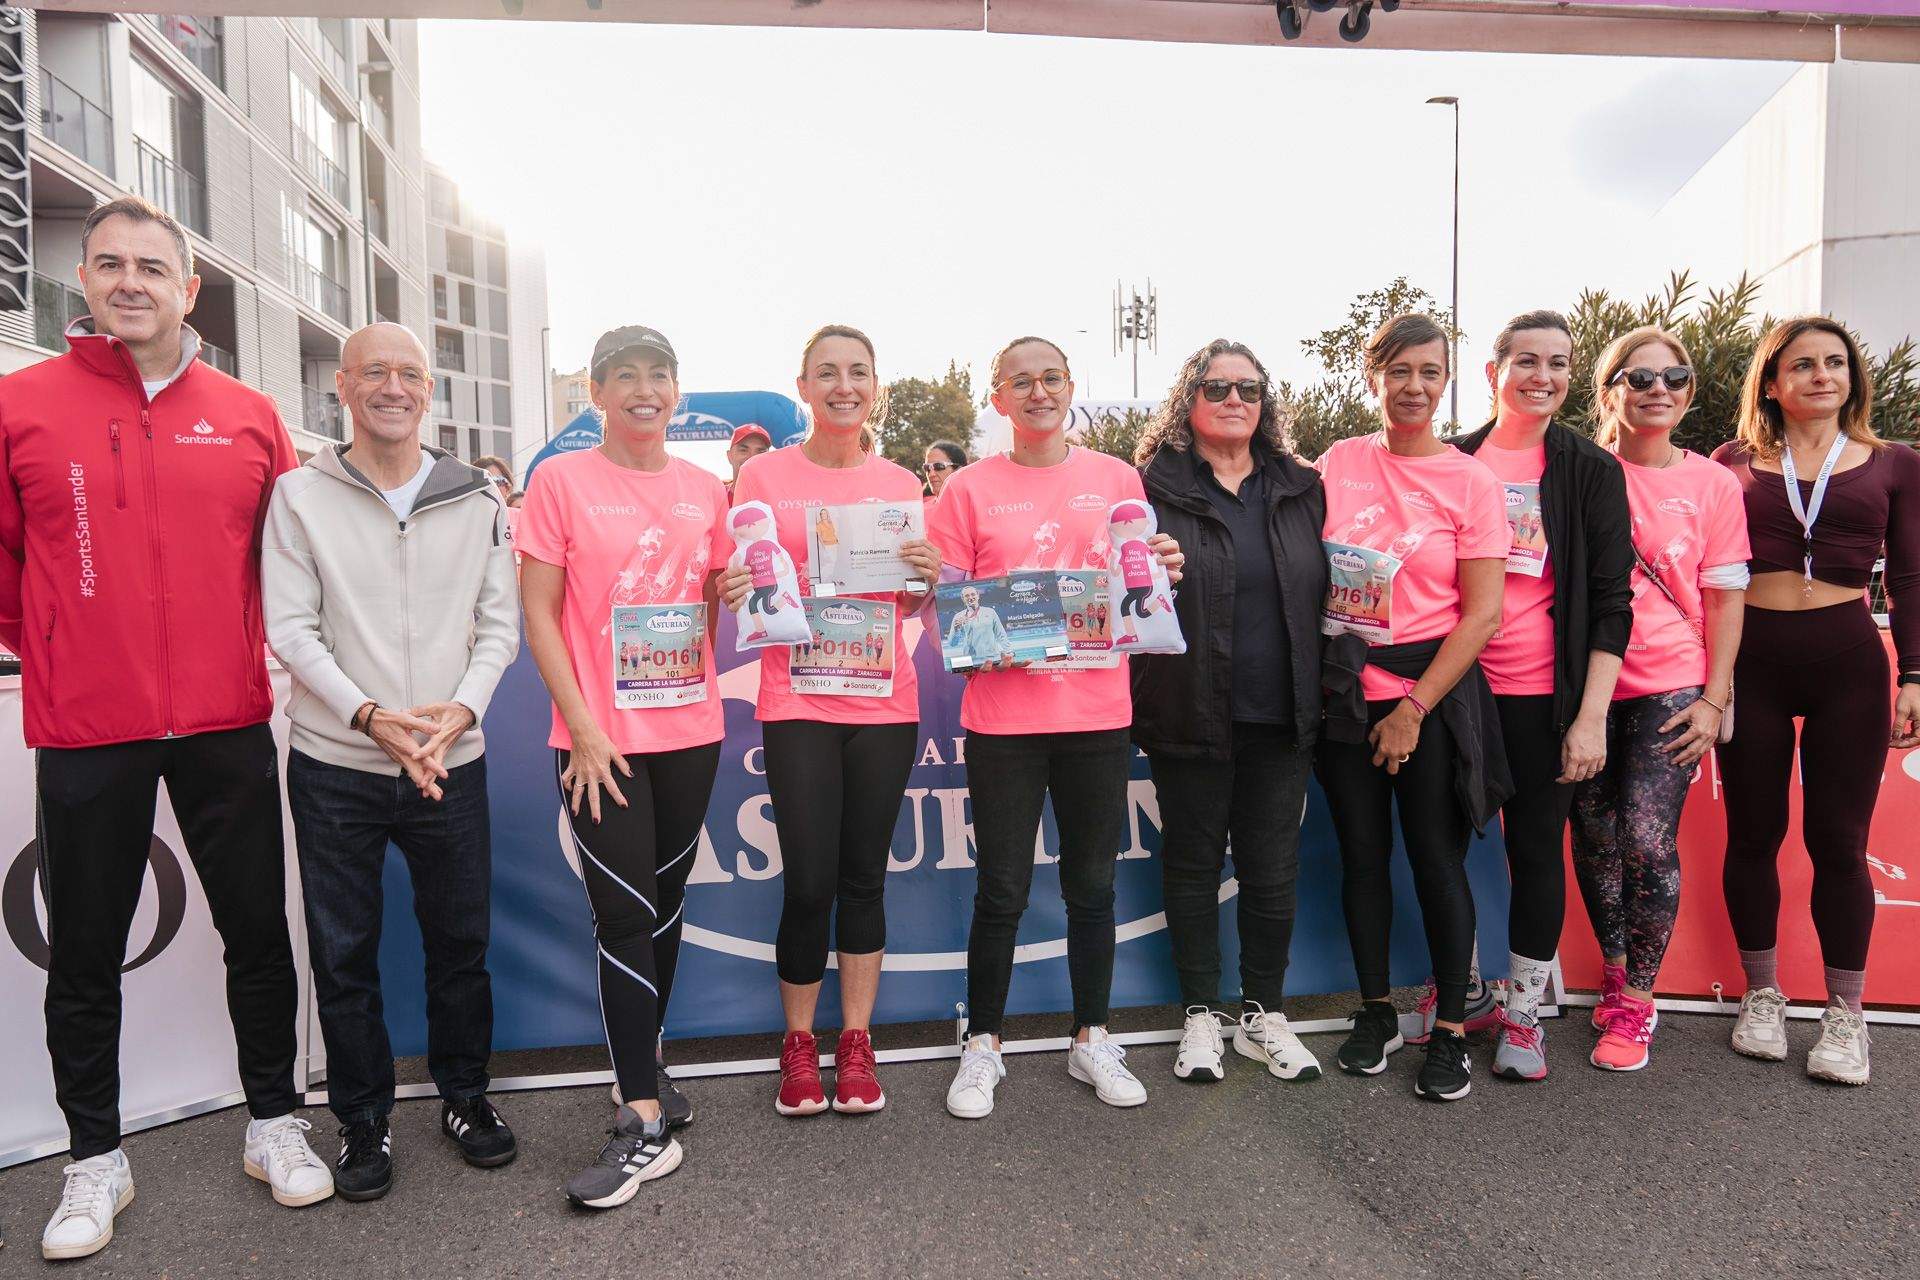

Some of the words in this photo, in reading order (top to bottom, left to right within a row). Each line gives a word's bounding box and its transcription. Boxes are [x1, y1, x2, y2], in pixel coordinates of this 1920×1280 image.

[175, 434, 233, 446] Santander
[667, 430, 730, 440] STURIANA
[588, 504, 637, 515] OYSHO
[988, 501, 1034, 516] OYSHO
[68, 461, 97, 598] #SportsSantander
[1332, 556, 1364, 569] ASTURIANA
[822, 611, 863, 621] ASTURIANA
[823, 640, 863, 657] 016
[653, 649, 690, 666] 016
[666, 670, 680, 678] 101
[800, 679, 831, 688] OYSHO
[628, 692, 665, 702] OYSHO
